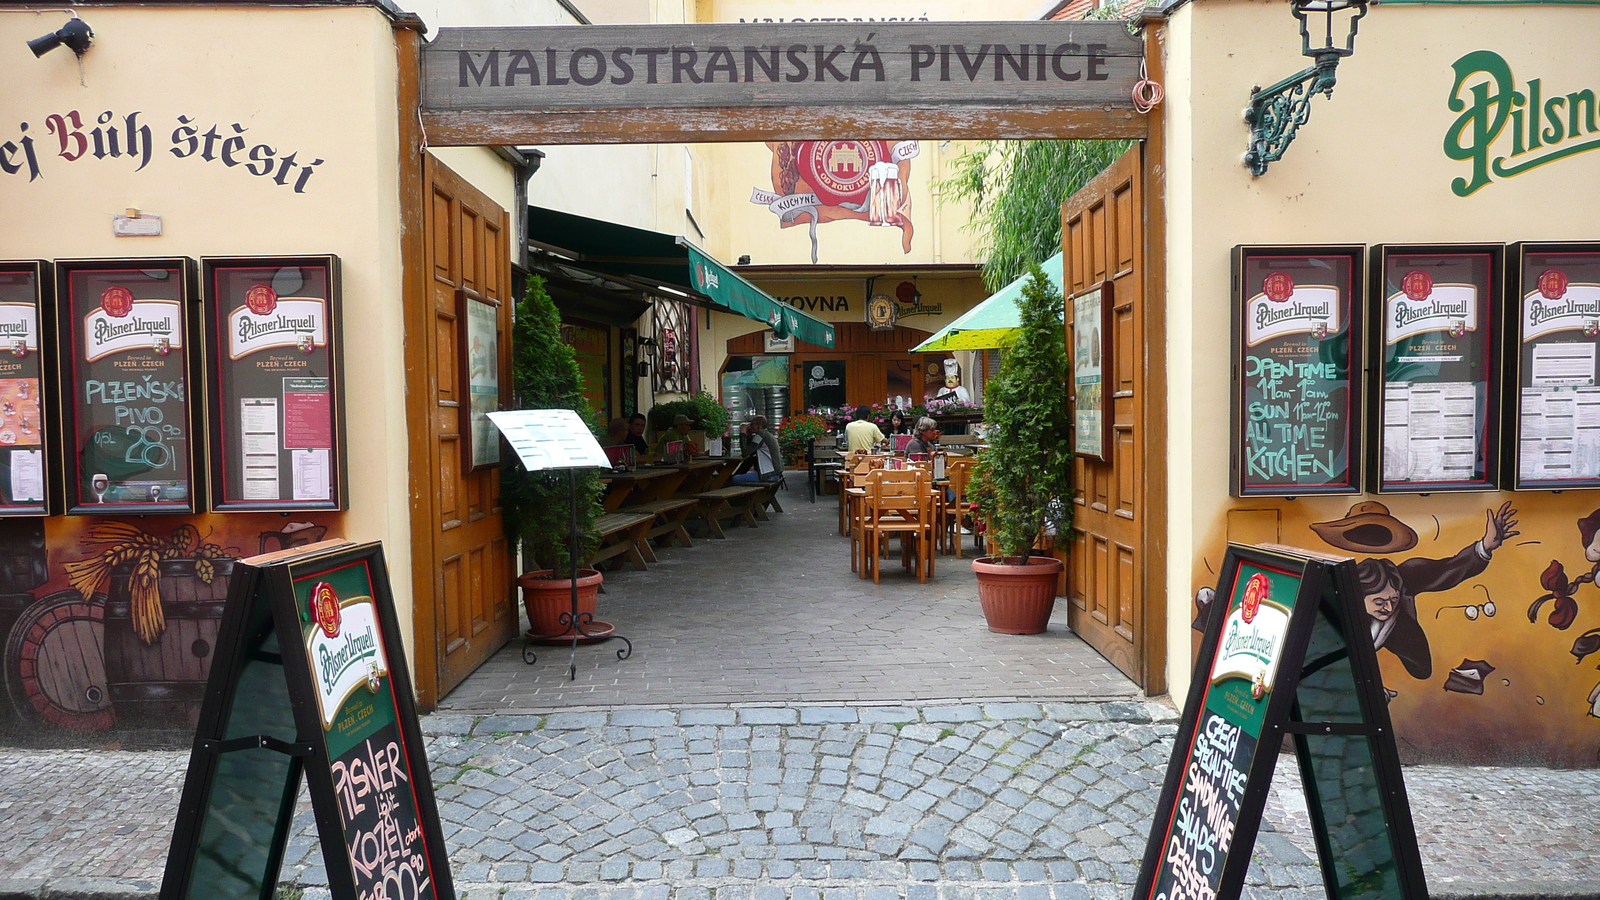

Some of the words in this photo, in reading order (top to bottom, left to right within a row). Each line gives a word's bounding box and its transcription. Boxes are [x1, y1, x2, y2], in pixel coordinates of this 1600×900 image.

[458, 33, 885, 88] MALOSTRANSKÁ
[909, 42, 1110, 82] PIVNICE
[1443, 49, 1600, 198] Pilsn
[45, 109, 153, 173] Bůh
[898, 142, 918, 157] CZECH
[820, 172, 831, 184] OD
[831, 180, 855, 191] ROKU
[917, 302, 942, 316] Urquell
[1256, 302, 1294, 330] Pilsner
[1293, 300, 1329, 321] Urquell
[1395, 301, 1432, 328] Pilsner
[1431, 299, 1467, 319] Urquell
[1530, 299, 1567, 327] Pilsner
[94, 317, 133, 345] Pilsner
[132, 316, 171, 336] Urquell
[239, 315, 278, 343] Pilsner
[277, 314, 315, 334] Urquell
[1246, 355, 1293, 379] OPEN
[115, 405, 163, 425] PIVO
[1248, 401, 1290, 421] SUN
[1246, 420, 1273, 452] ALL
[1246, 444, 1334, 481] KITCHEN
[1223, 619, 1252, 661] Pilsner
[1249, 625, 1276, 662] Urquell
[318, 642, 348, 696] Pilsner
[344, 625, 374, 663] Urquell
[357, 704, 374, 720] CZECH
[1206, 714, 1242, 761] CZECH
[331, 739, 408, 820] PILSNER
